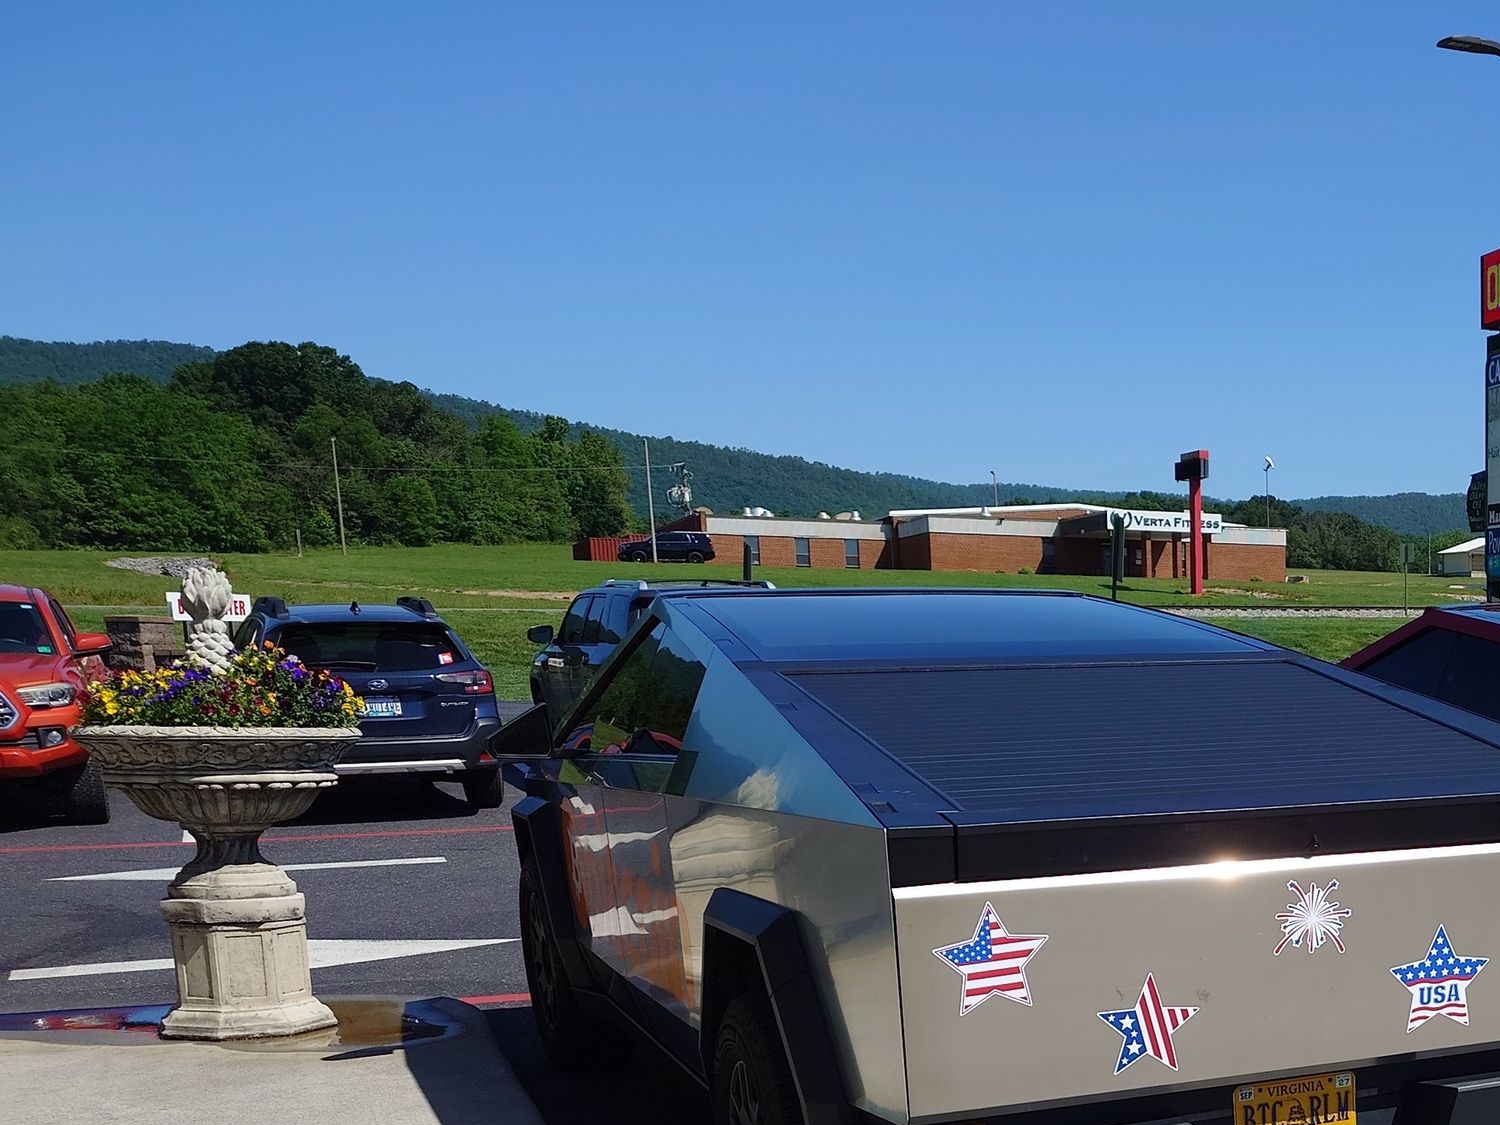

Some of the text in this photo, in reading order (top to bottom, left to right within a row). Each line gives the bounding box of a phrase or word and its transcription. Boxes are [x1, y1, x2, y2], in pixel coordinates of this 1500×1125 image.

[1134, 515, 1220, 529] VERTA FITESS
[1419, 983, 1461, 1005] USA
[1266, 1080, 1325, 1098] VIRGINIA
[1338, 1078, 1350, 1086] 27
[1240, 1091, 1253, 1101] SEP
